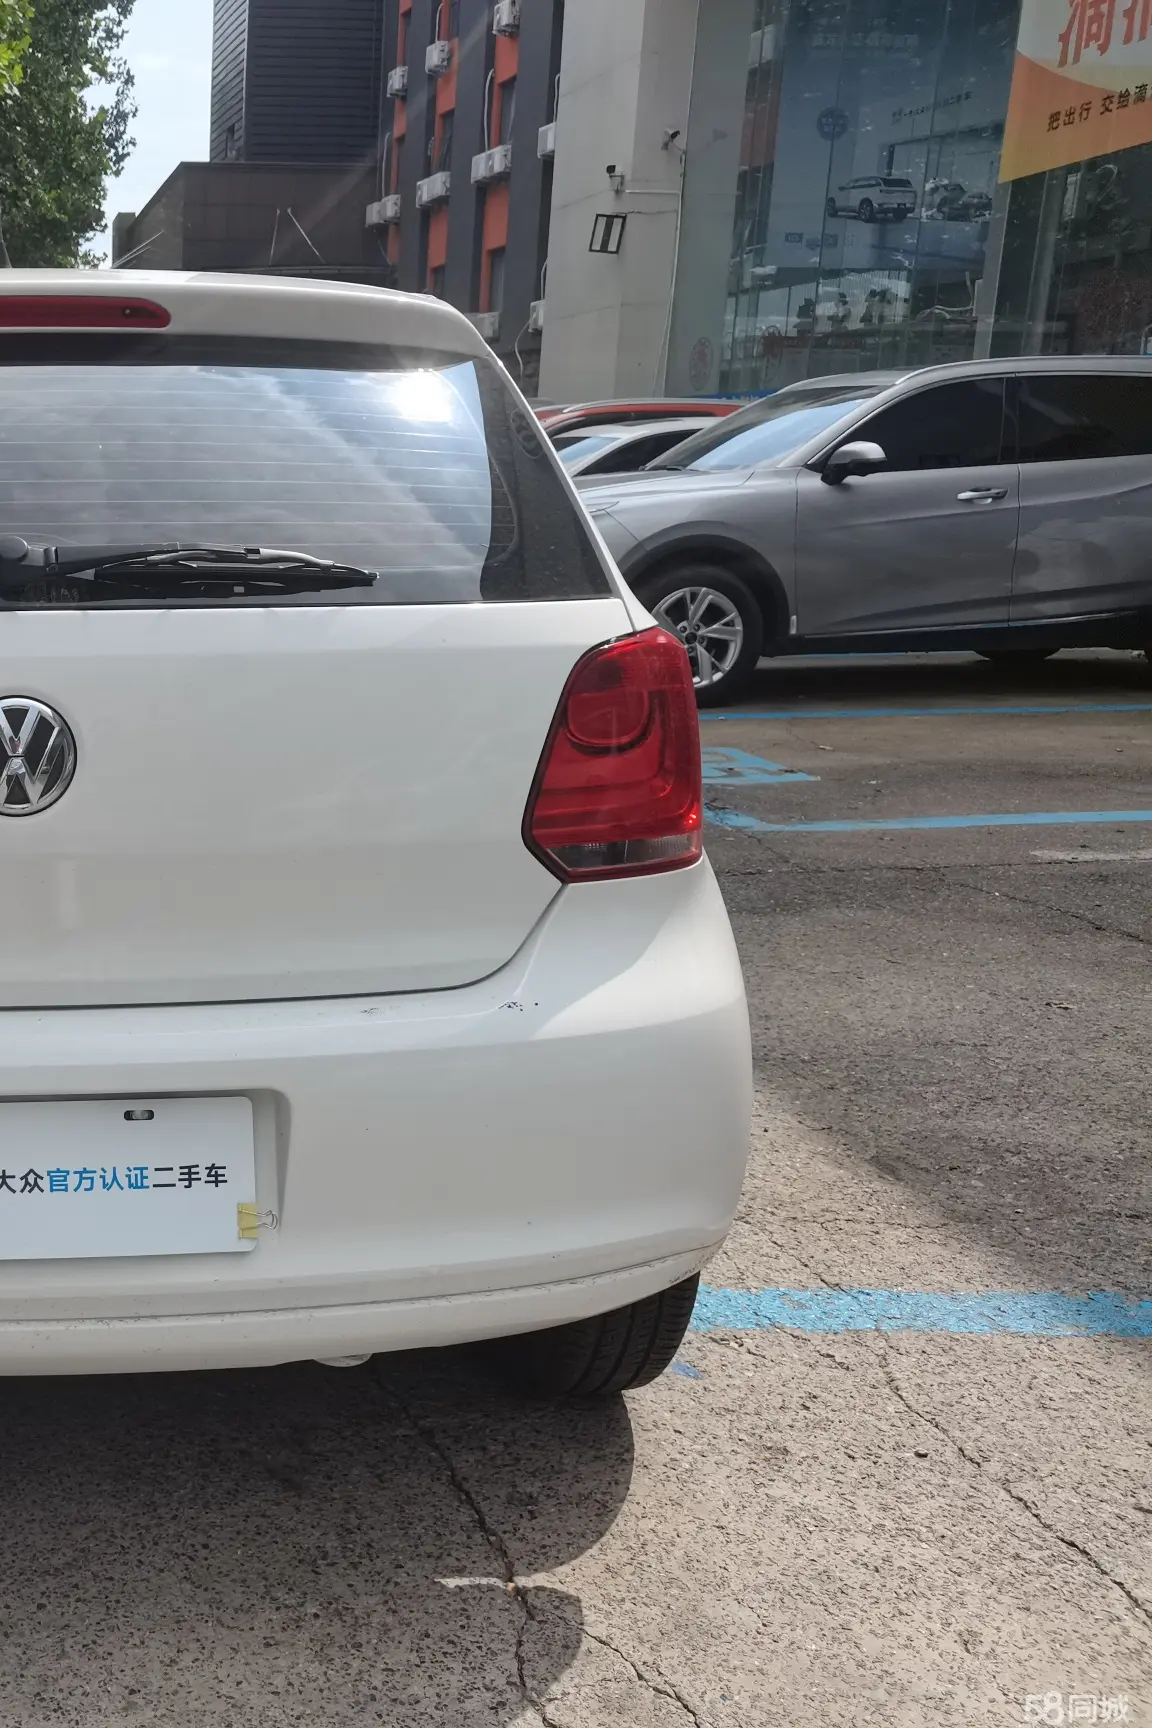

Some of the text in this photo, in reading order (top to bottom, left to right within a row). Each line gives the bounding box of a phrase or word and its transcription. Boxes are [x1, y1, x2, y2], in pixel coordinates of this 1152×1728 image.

[1047, 83, 1152, 132] 把出行 交给滴
